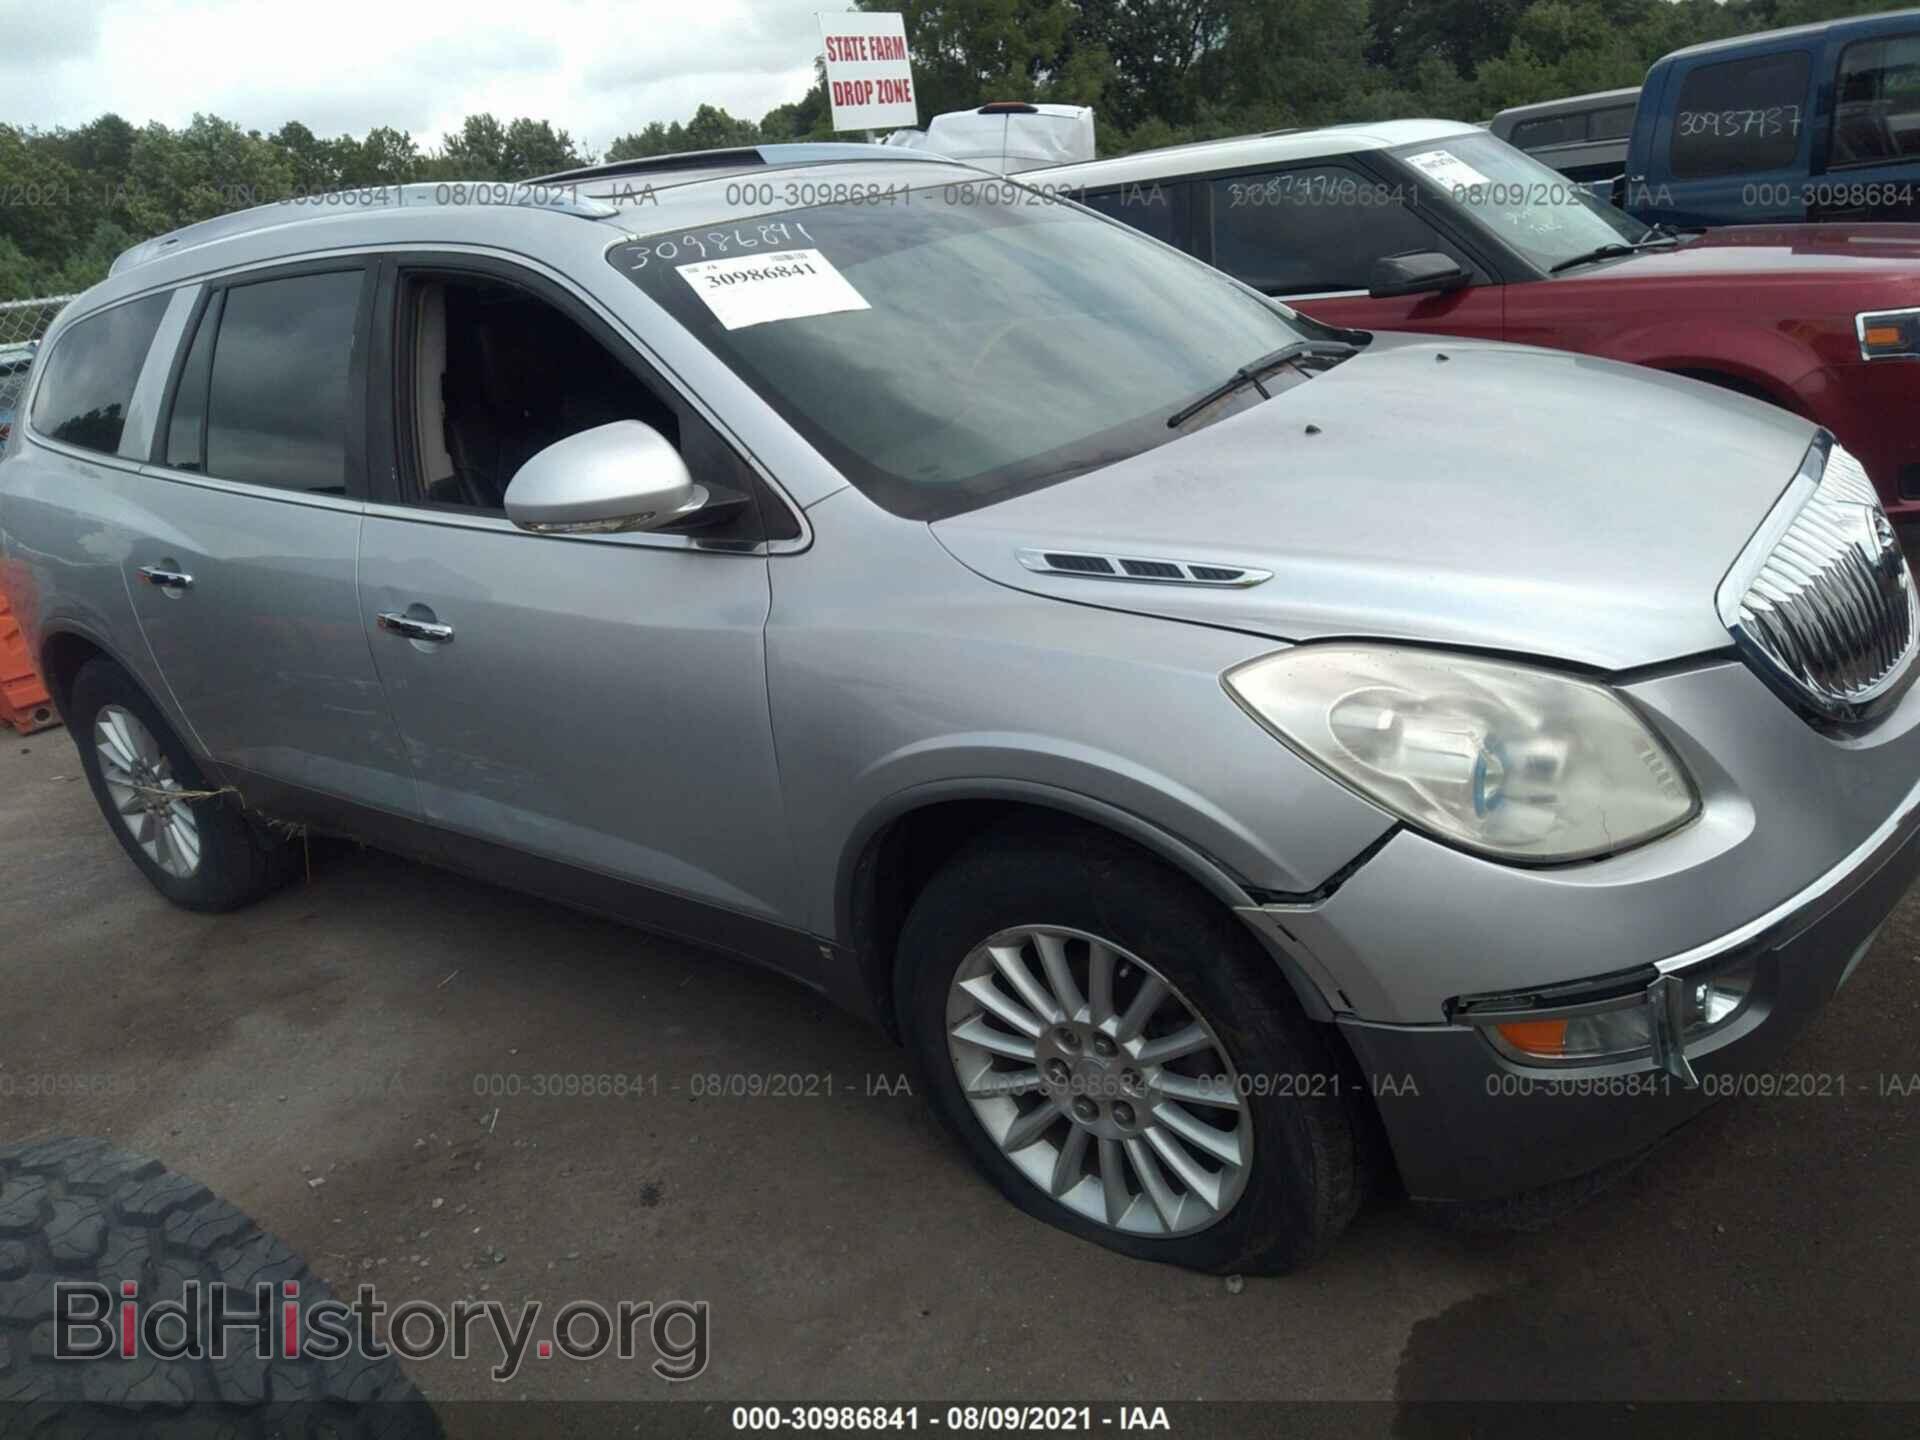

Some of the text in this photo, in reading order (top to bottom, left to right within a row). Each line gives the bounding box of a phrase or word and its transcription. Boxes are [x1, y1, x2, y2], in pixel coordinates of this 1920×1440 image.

[826, 36, 906, 62] STATE FARM
[833, 79, 912, 107] DROP ZONE
[704, 263, 817, 289] 30986841
